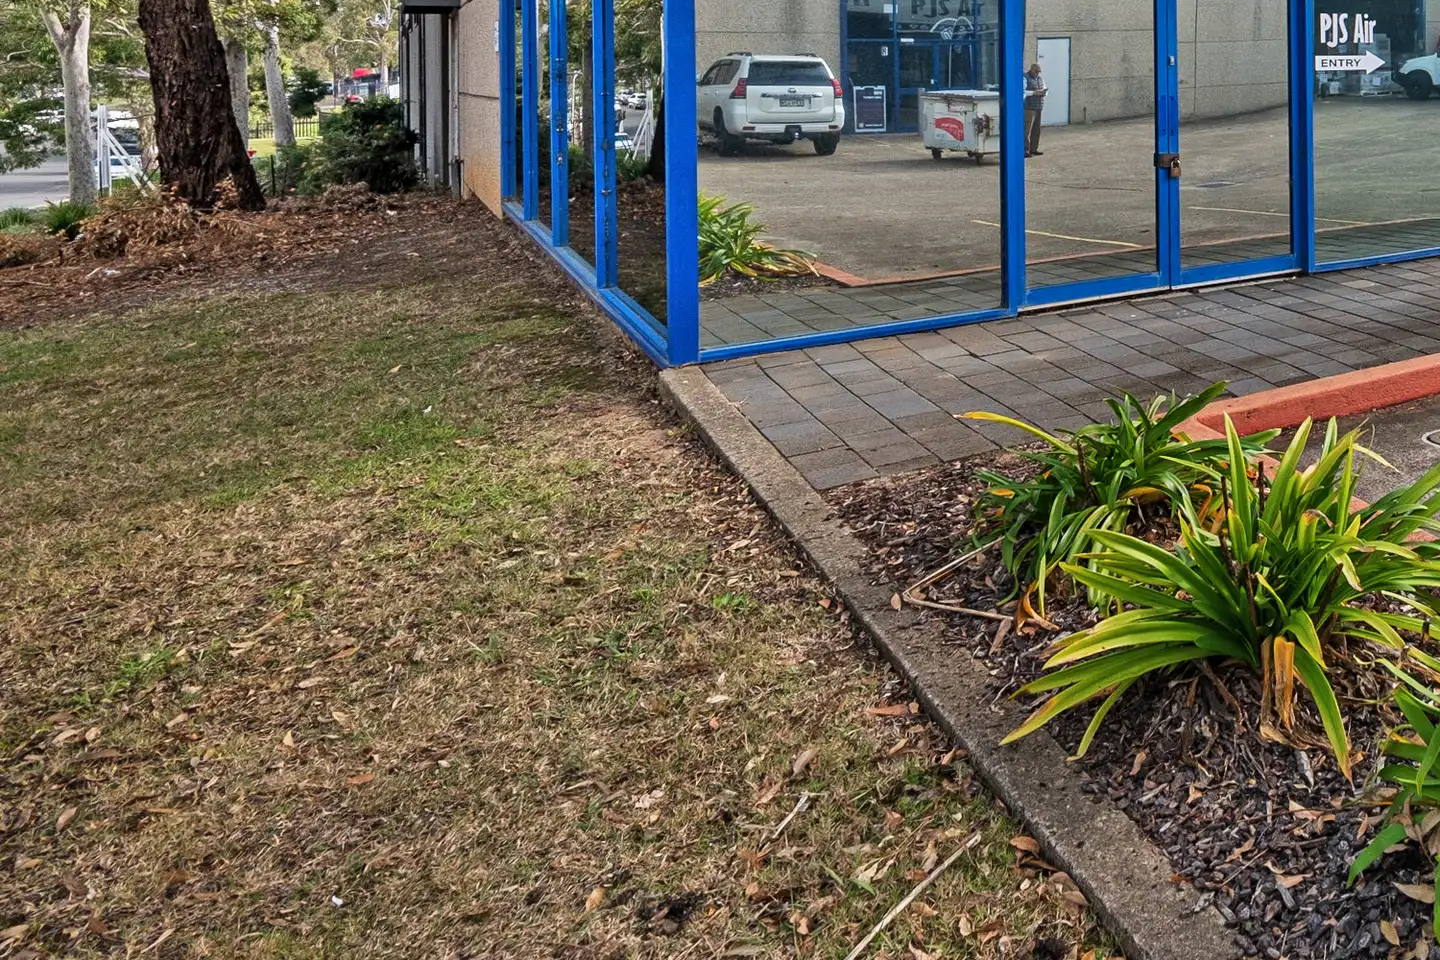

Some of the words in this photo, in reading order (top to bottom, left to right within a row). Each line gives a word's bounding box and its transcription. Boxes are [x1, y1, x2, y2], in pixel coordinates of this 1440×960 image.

[1320, 13, 1348, 48] PJS
[1353, 13, 1377, 44] Air
[1321, 58, 1361, 68] ENTRY
